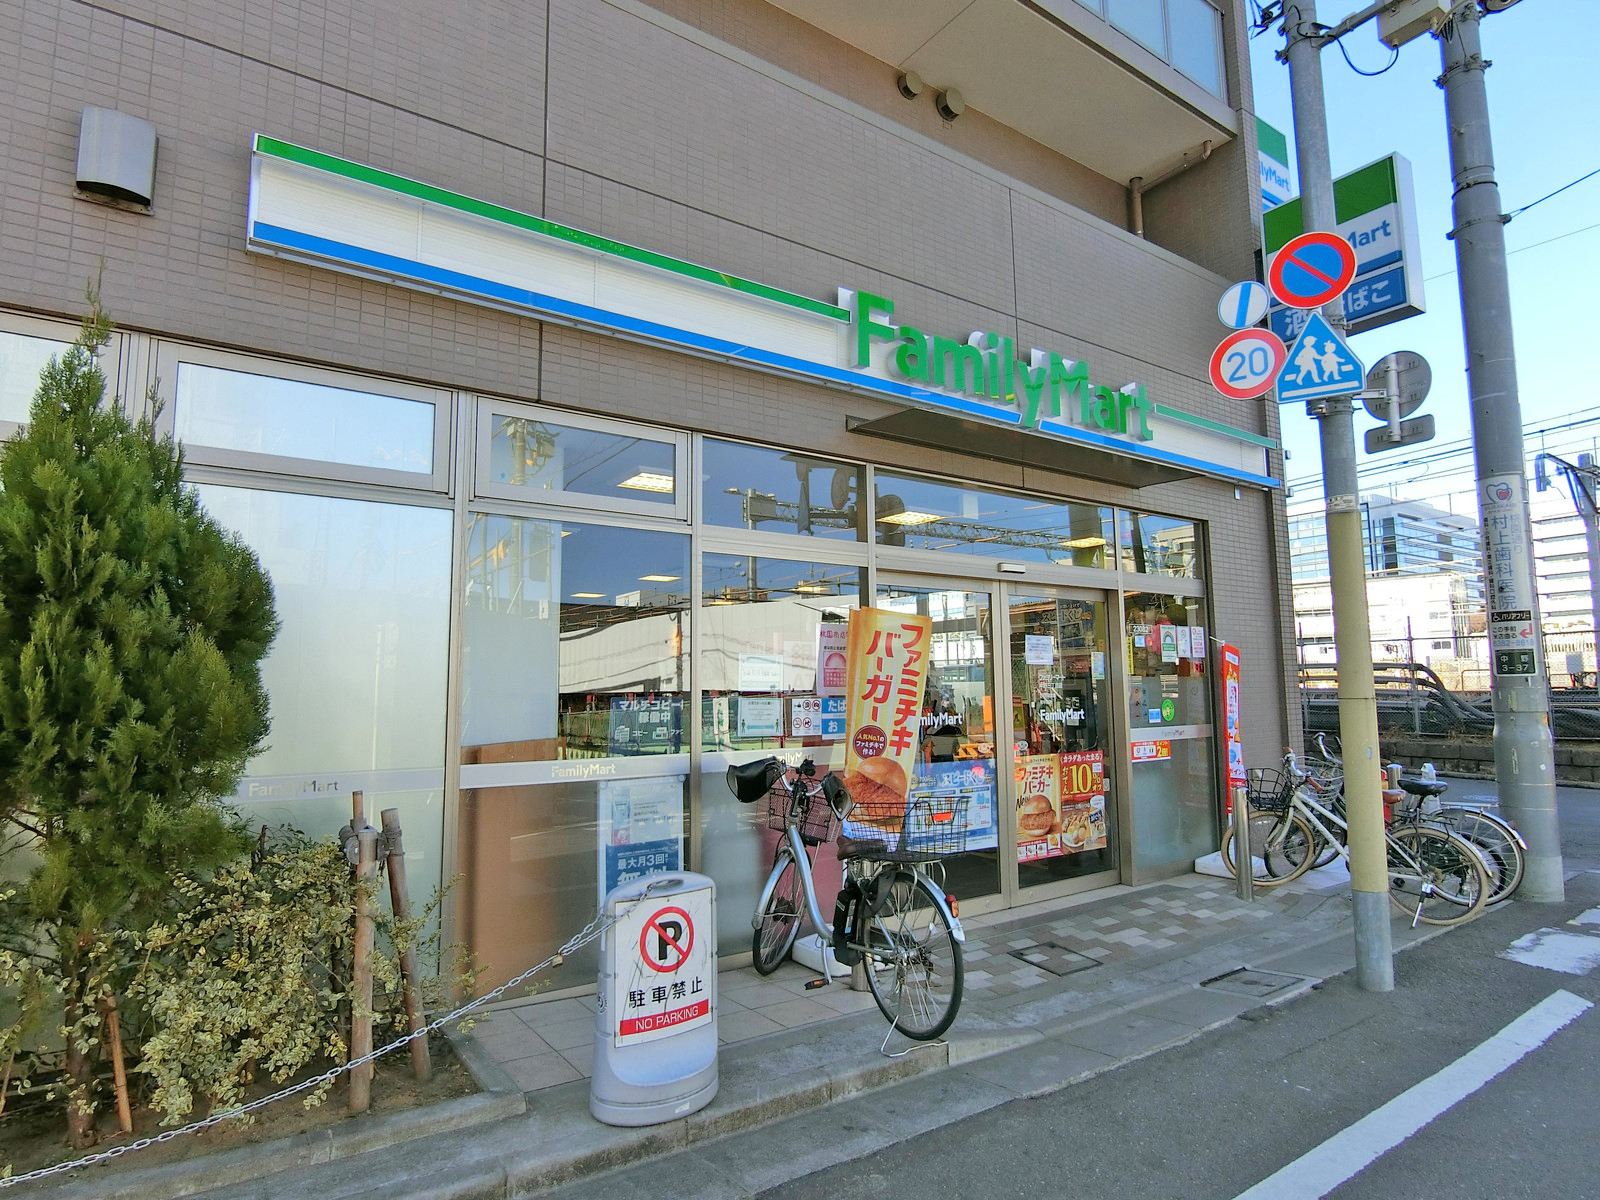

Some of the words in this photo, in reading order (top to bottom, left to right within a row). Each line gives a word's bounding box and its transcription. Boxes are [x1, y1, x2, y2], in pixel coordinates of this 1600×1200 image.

[856, 290, 1154, 442] FamilyMart
[1226, 346, 1269, 383] 20
[1509, 513, 1523, 555] 桃園通り
[1491, 514, 1517, 610] 村上歯科医院
[861, 630, 902, 723] バーガー
[889, 623, 924, 757] ファミチキ
[619, 699, 684, 711] マルチコピー
[1040, 708, 1085, 723] FamilyMart
[551, 763, 616, 779] FamilyMart
[1023, 778, 1050, 794] バーガー
[1069, 763, 1092, 794] 10
[628, 976, 703, 1009] 駐車禁止
[635, 1018, 653, 1031] NO
[655, 1005, 699, 1027] PARKING
